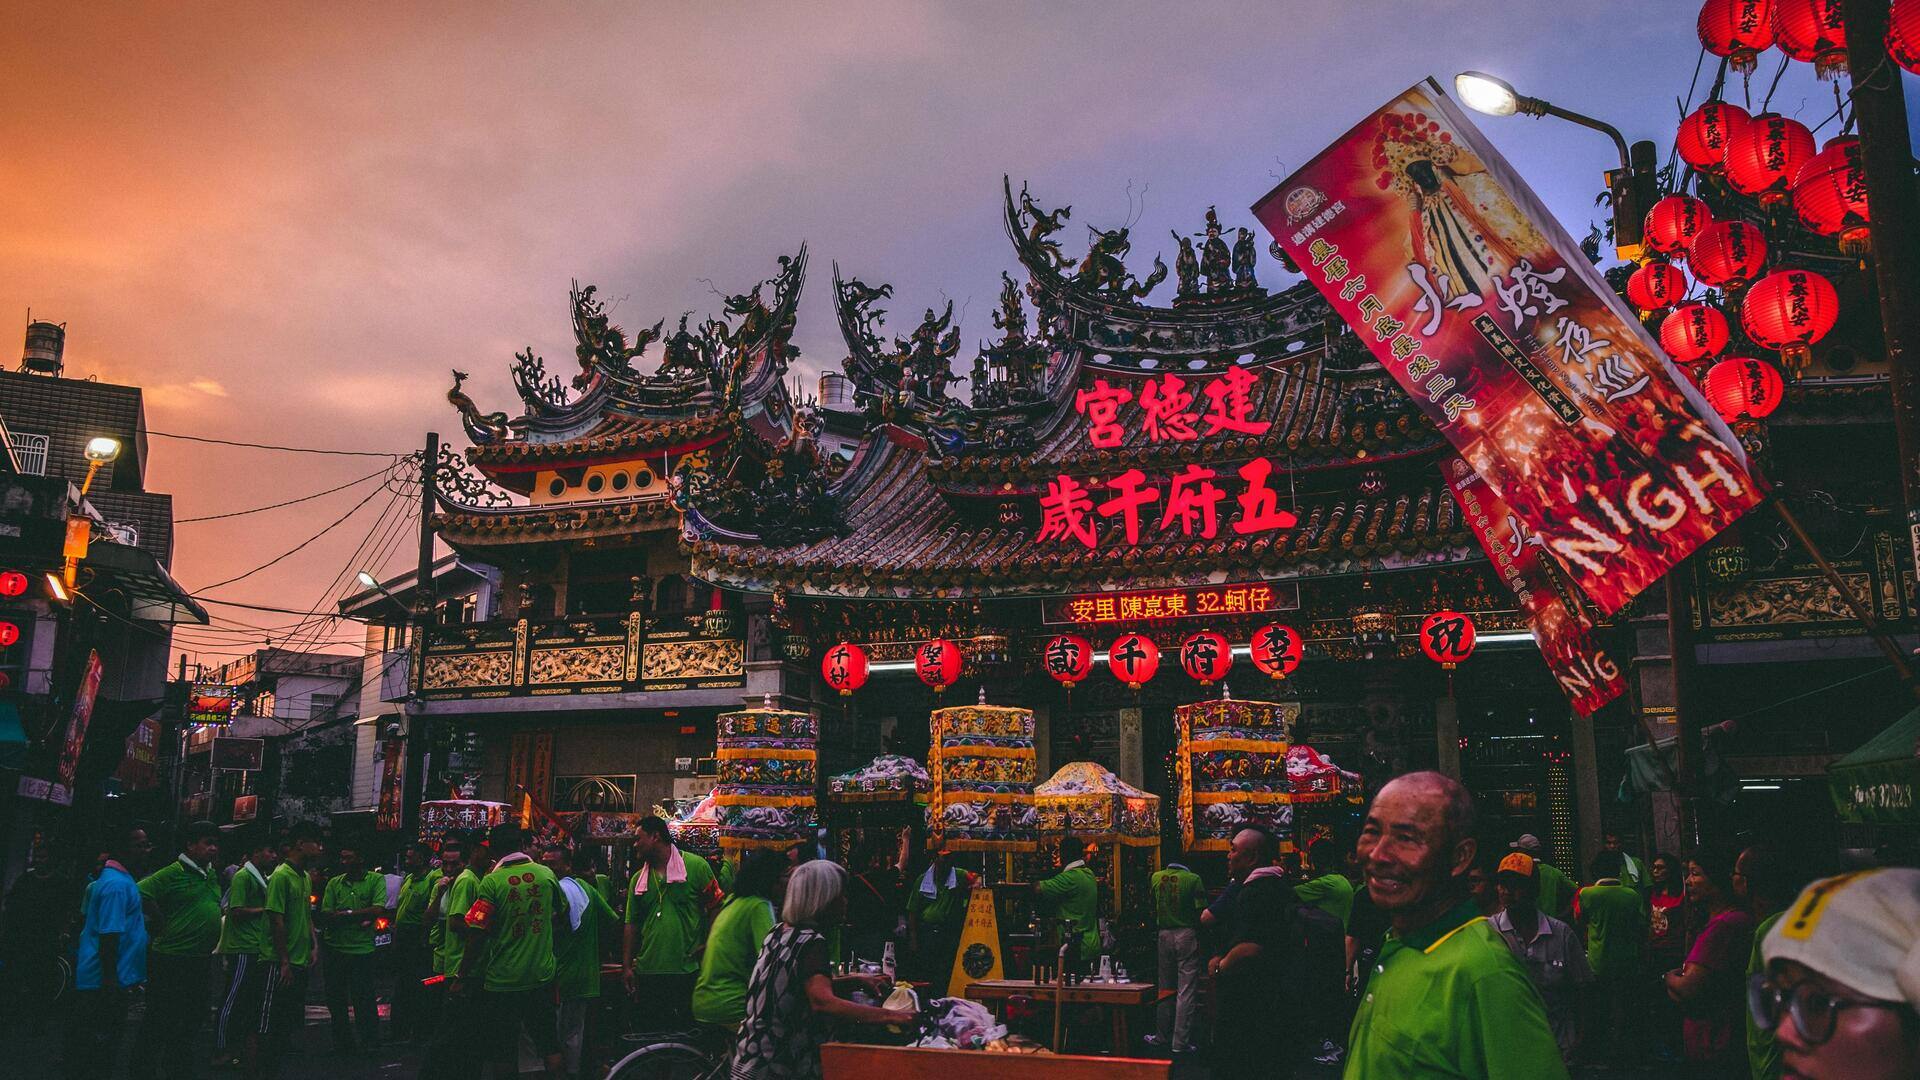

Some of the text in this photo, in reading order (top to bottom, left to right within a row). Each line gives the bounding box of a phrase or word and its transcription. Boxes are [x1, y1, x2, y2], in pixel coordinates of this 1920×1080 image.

[1738, 0, 1758, 33] 民安
[1075, 366, 1272, 449] 建德宮
[830, 646, 850, 687] 千秋
[1115, 637, 1147, 675] 千
[1186, 635, 1219, 674] 府
[1257, 627, 1296, 670] 李
